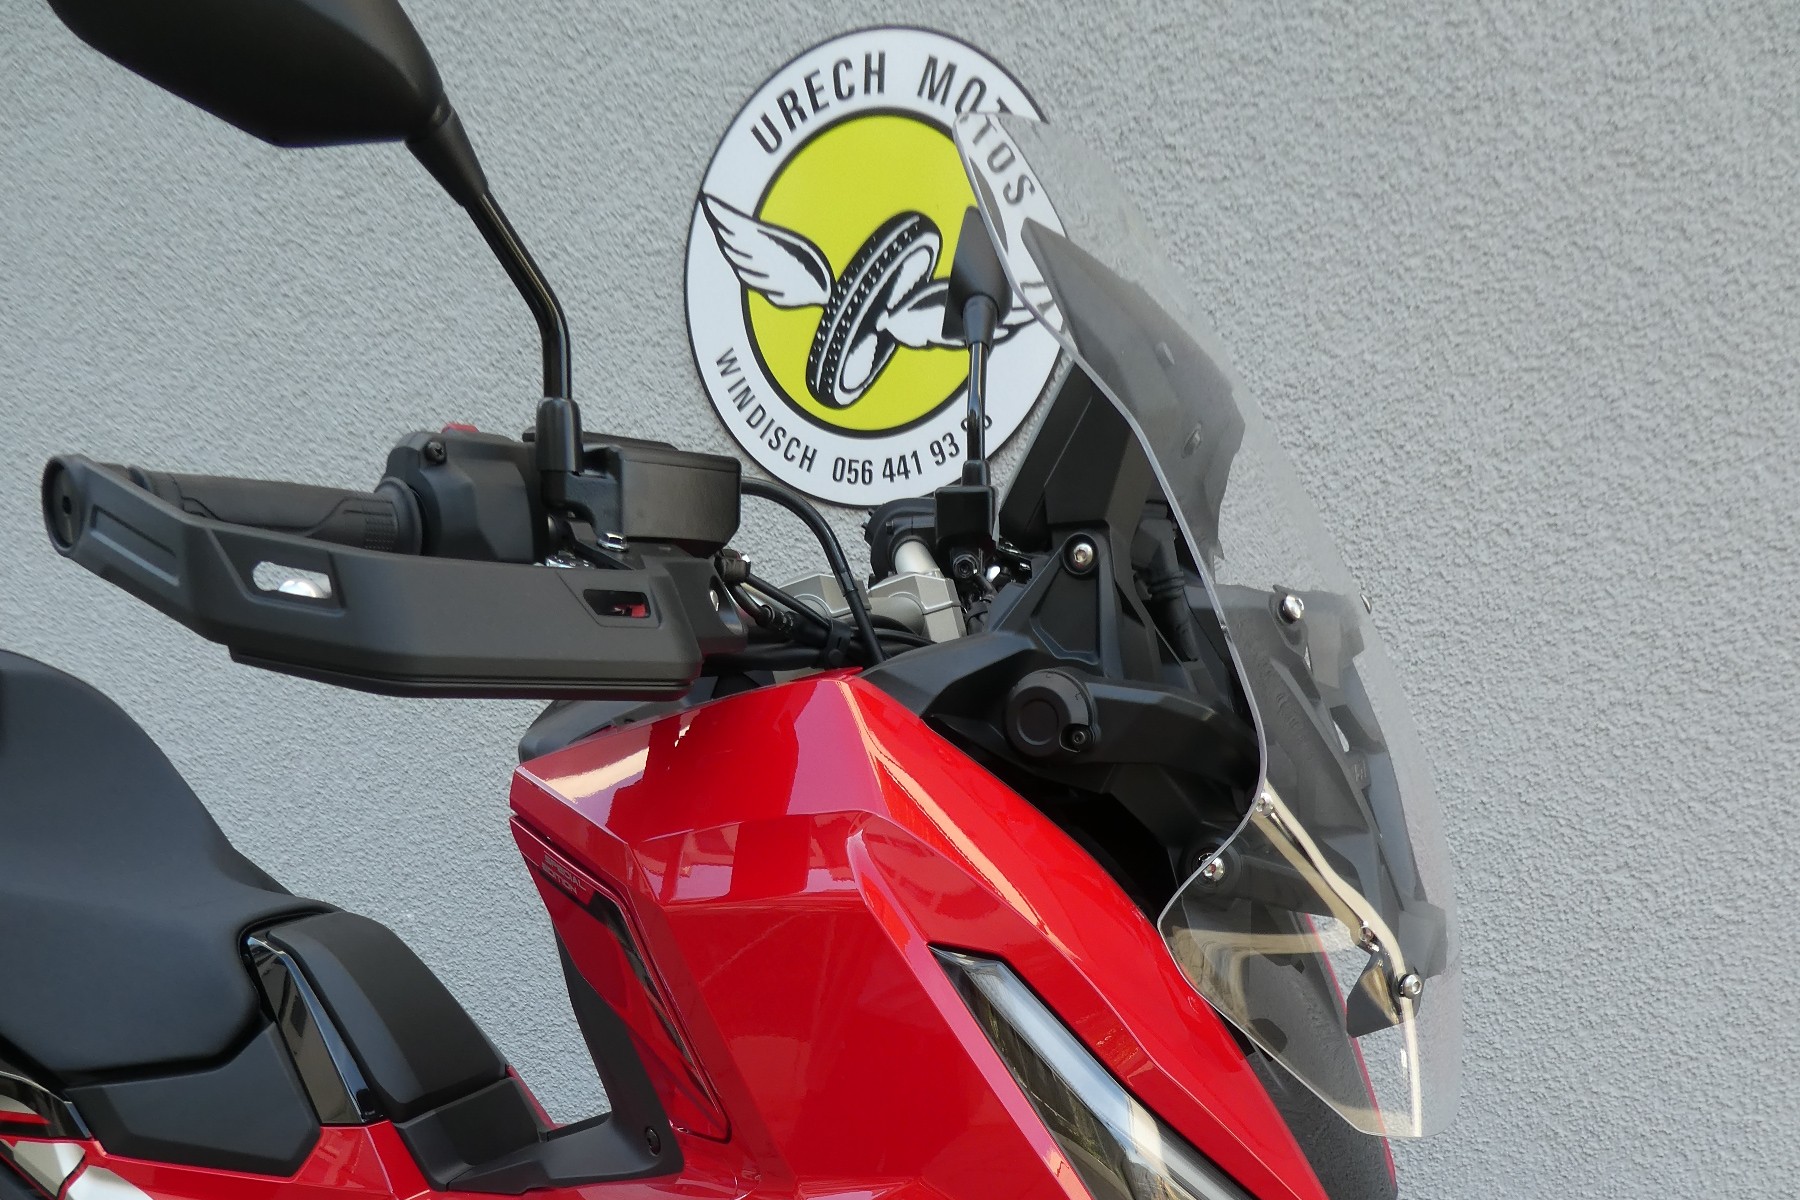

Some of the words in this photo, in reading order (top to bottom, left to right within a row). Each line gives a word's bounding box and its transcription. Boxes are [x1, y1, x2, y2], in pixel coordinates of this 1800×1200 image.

[749, 51, 886, 154] URECH
[916, 53, 1036, 206] MOTOS
[715, 347, 818, 474] WINDISCH
[832, 457, 874, 486] 056
[882, 451, 924, 484] 441
[931, 432, 960, 466] 93
